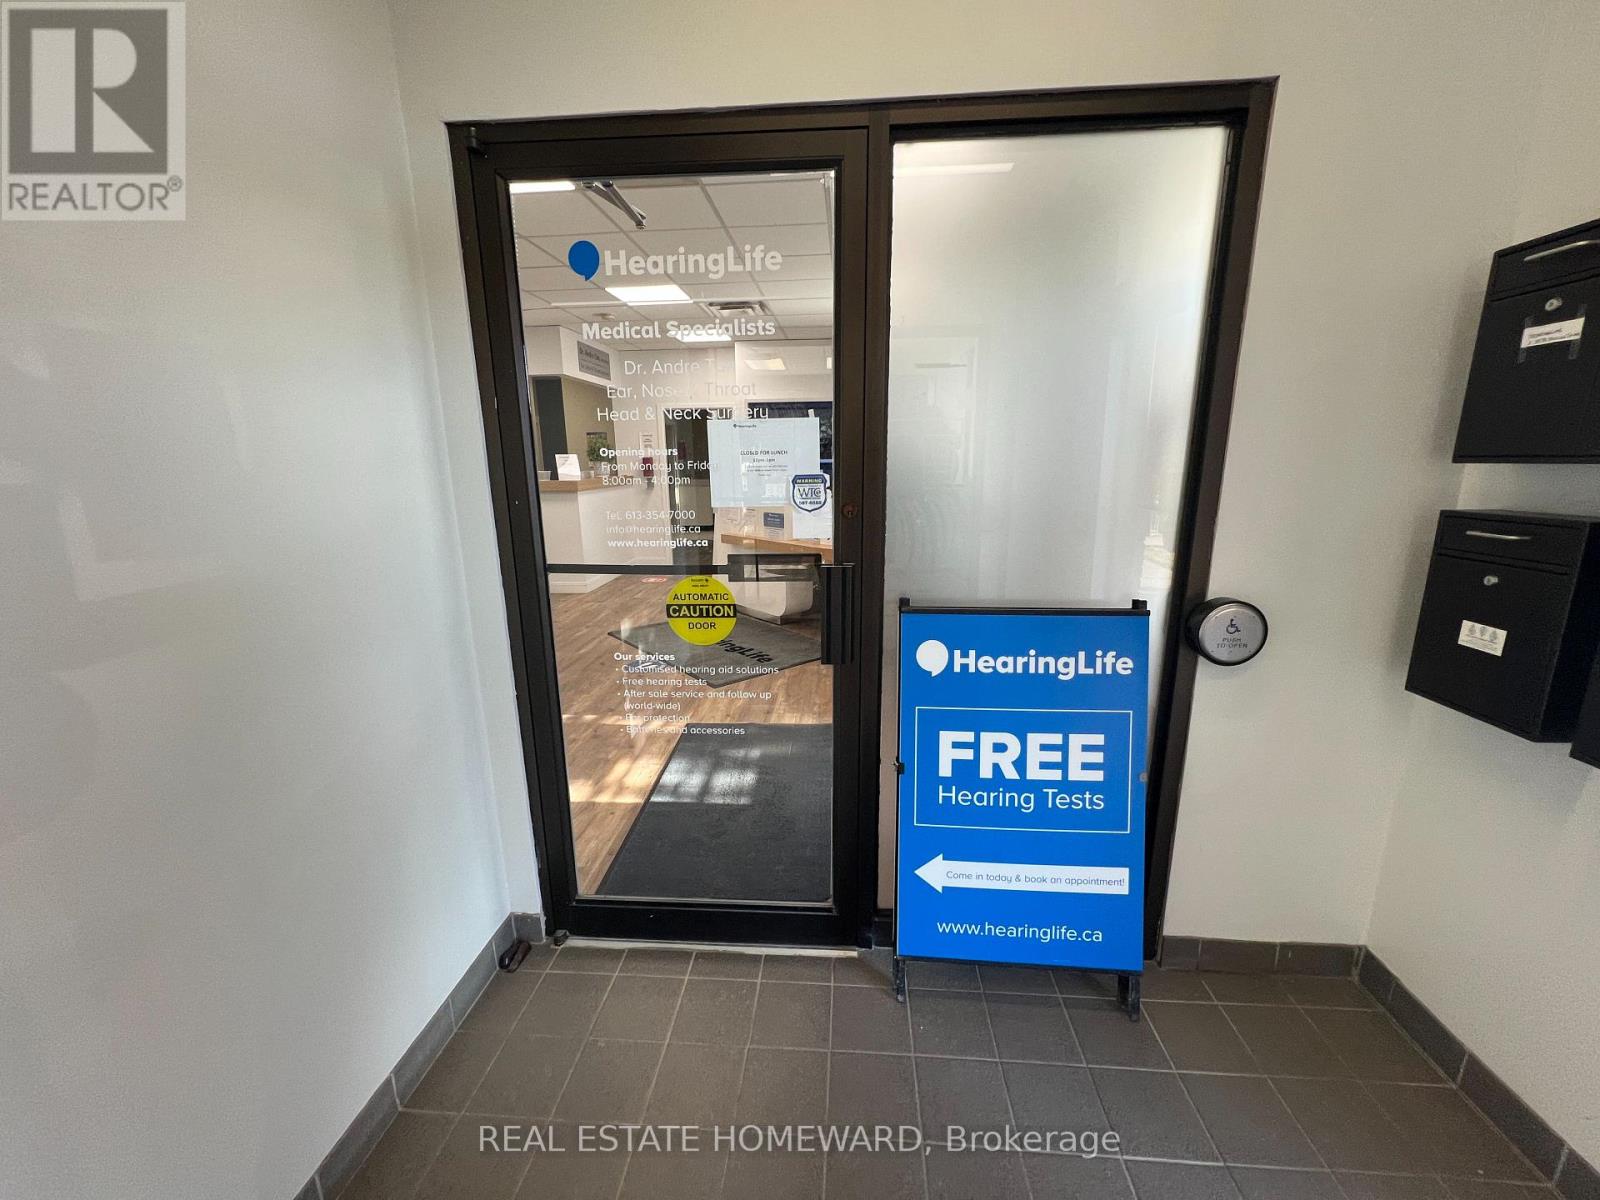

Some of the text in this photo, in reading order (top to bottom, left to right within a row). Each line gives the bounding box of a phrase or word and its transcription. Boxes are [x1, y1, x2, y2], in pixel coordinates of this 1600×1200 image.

[604, 244, 782, 279] HearingLife
[581, 318, 776, 340] Medical Specialists
[624, 360, 647, 375] Dr.
[652, 359, 700, 375] Andre
[607, 384, 637, 399] Ear,
[705, 382, 757, 396] Throat
[597, 406, 769, 421] Head & Neck Surery
[599, 447, 679, 458] Opening hours
[601, 461, 627, 471] From
[630, 461, 672, 472] Monday
[674, 461, 685, 471] to
[602, 476, 642, 486] 8:00am
[651, 476, 691, 486] 4:00pm
[606, 524, 701, 536] info@hearinglife.ca
[607, 538, 709, 549] www.hearinglife.ca
[672, 593, 729, 601] AUTOMATIC
[669, 605, 734, 617] CAUTION
[688, 621, 717, 630] DOOR
[613, 652, 676, 661] Our services
[621, 664, 780, 675] Customised hearing aid solutions
[953, 648, 1134, 681] HearingLife
[622, 677, 708, 687] Free hearing tests
[623, 689, 772, 700] After sale service and follow up
[624, 702, 681, 711] (world-wide)
[643, 714, 690, 723] protection
[690, 727, 746, 735] accessories
[938, 730, 1105, 782] FREE
[938, 785, 1105, 813] Hearing Tests
[946, 870, 1126, 887] Come in today & book an appointment!
[937, 921, 1103, 943] www.hearinglife.ca
